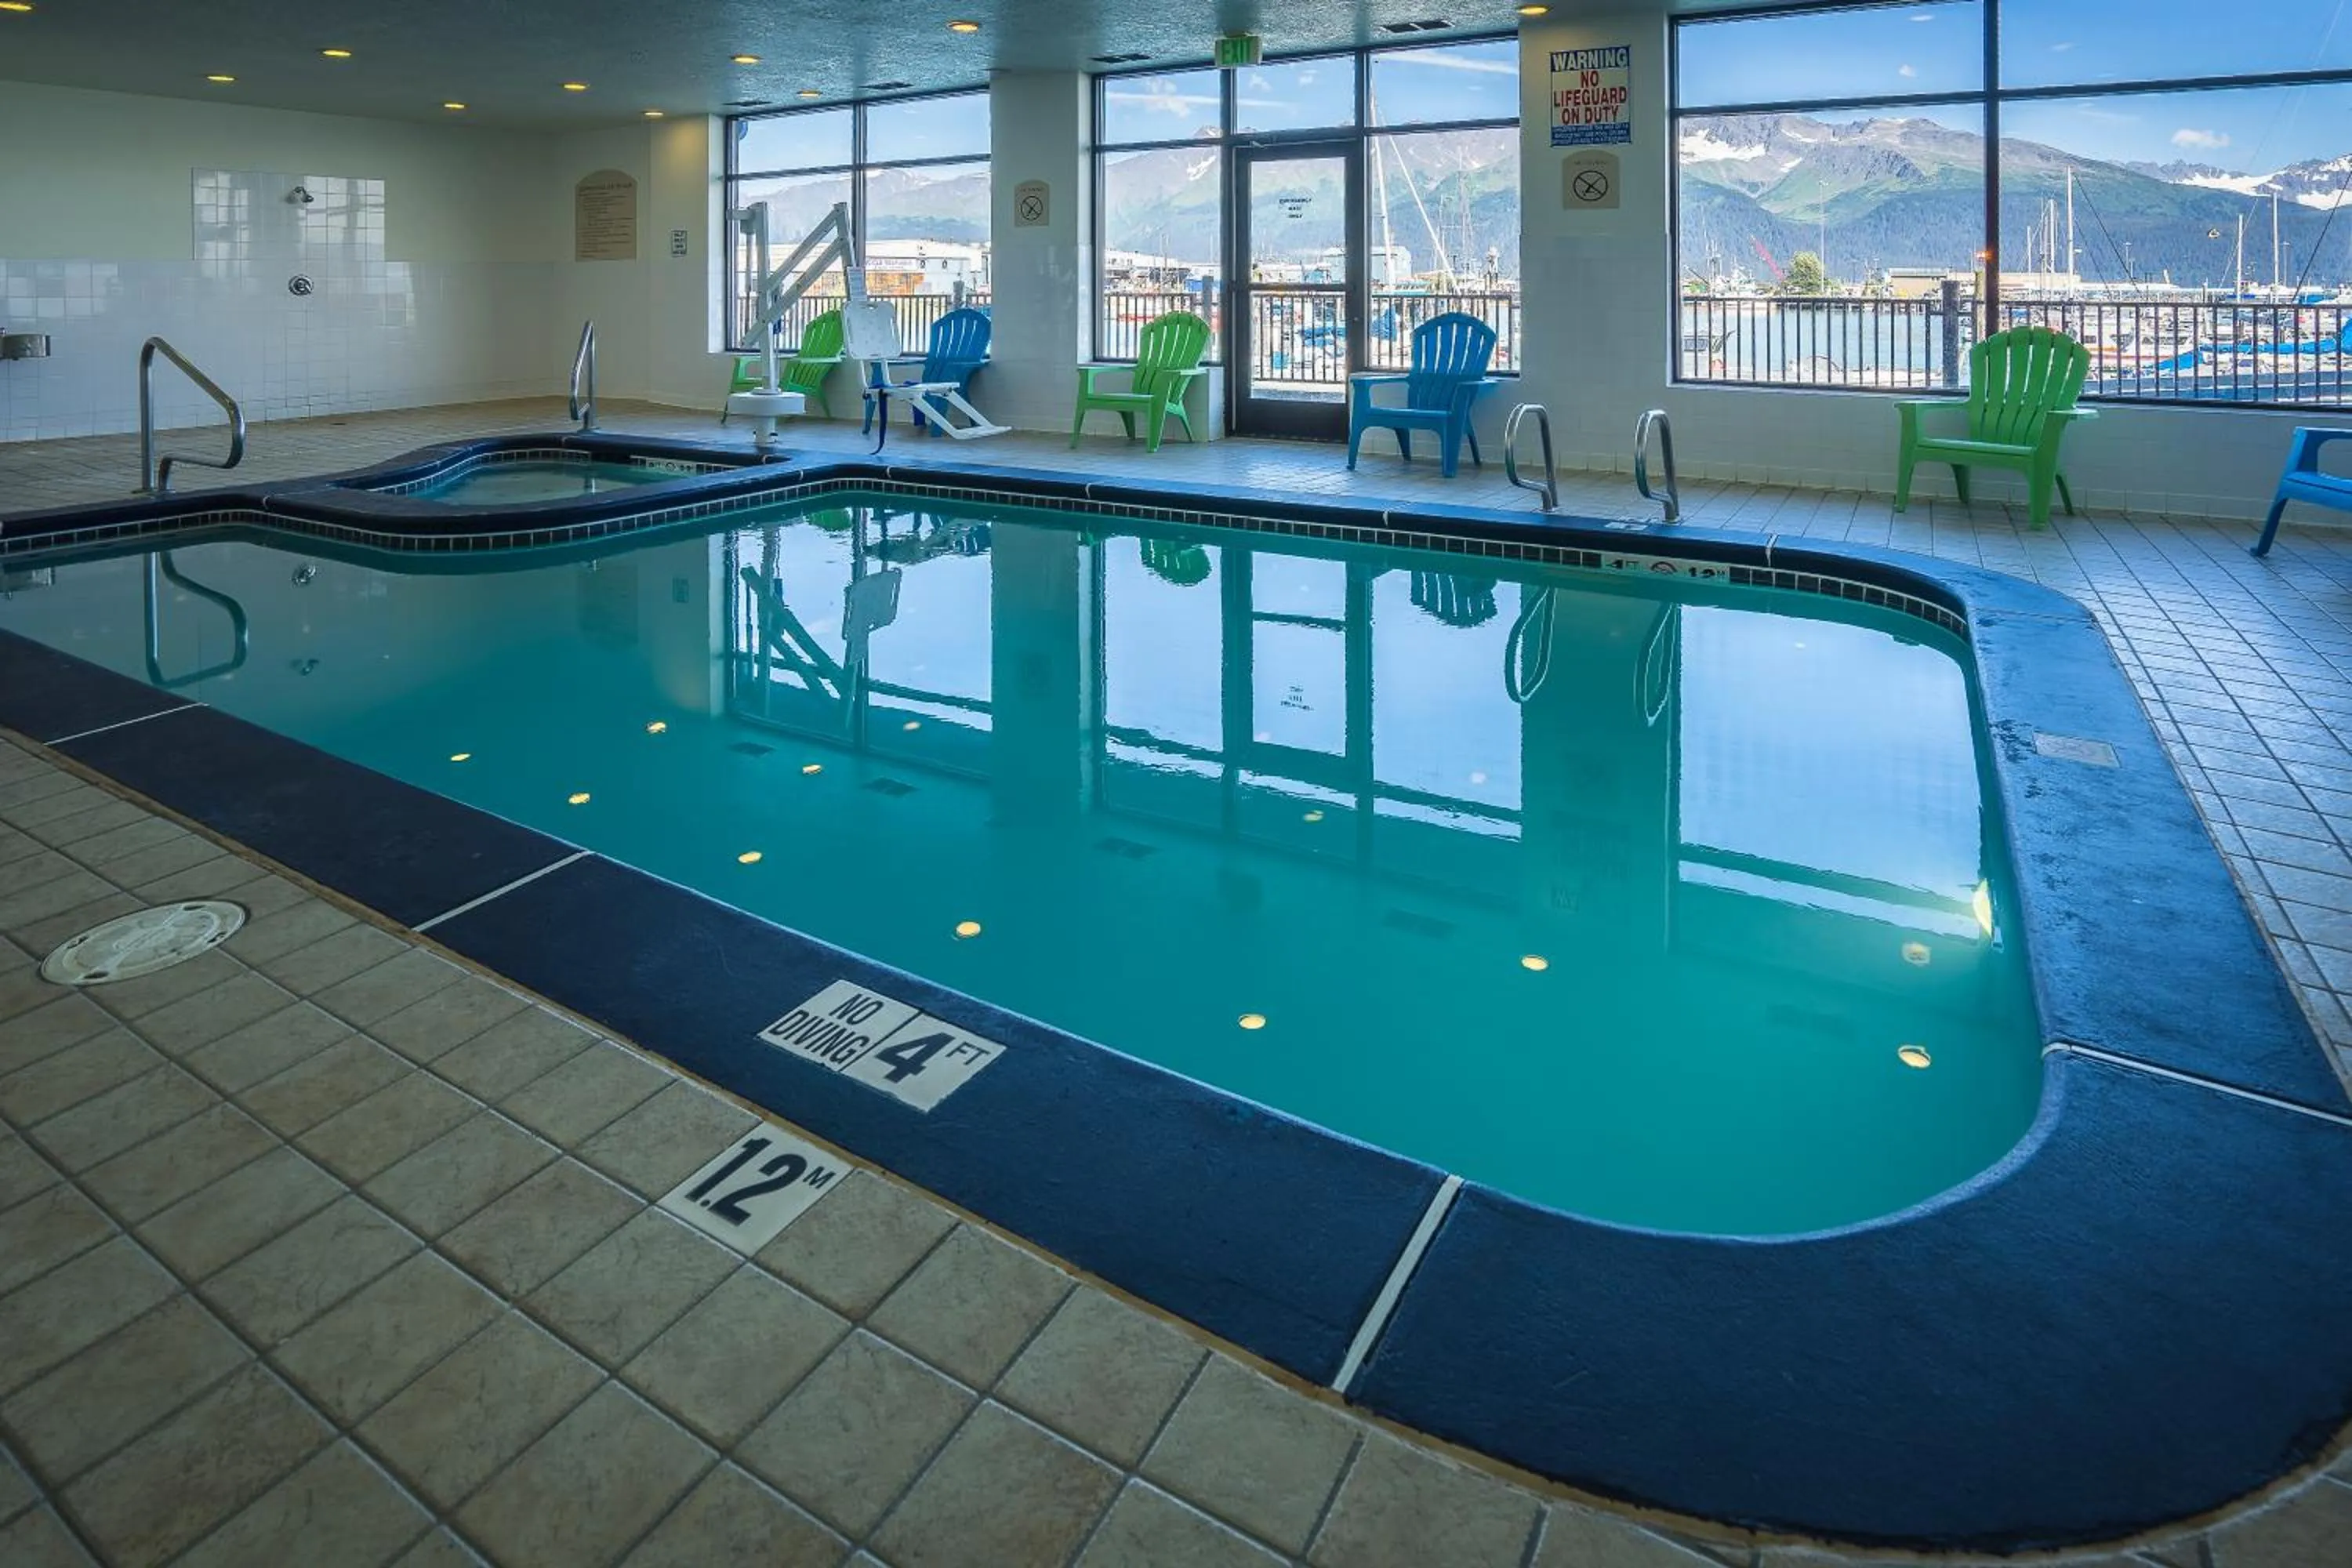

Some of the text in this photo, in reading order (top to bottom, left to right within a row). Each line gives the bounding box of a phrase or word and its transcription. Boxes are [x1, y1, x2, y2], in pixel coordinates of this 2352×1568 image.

[1221, 39, 1250, 64] EXIT
[1552, 49, 1628, 71] WARNING
[1581, 71, 1599, 88] NO
[1554, 86, 1627, 107] LIFEGUARD
[1562, 105, 1618, 125] ON DUTY
[829, 993, 884, 1025] NO
[768, 1010, 869, 1065] DIVING
[875, 1033, 990, 1083] 4 FT
[684, 1138, 837, 1227] 1.2 M
